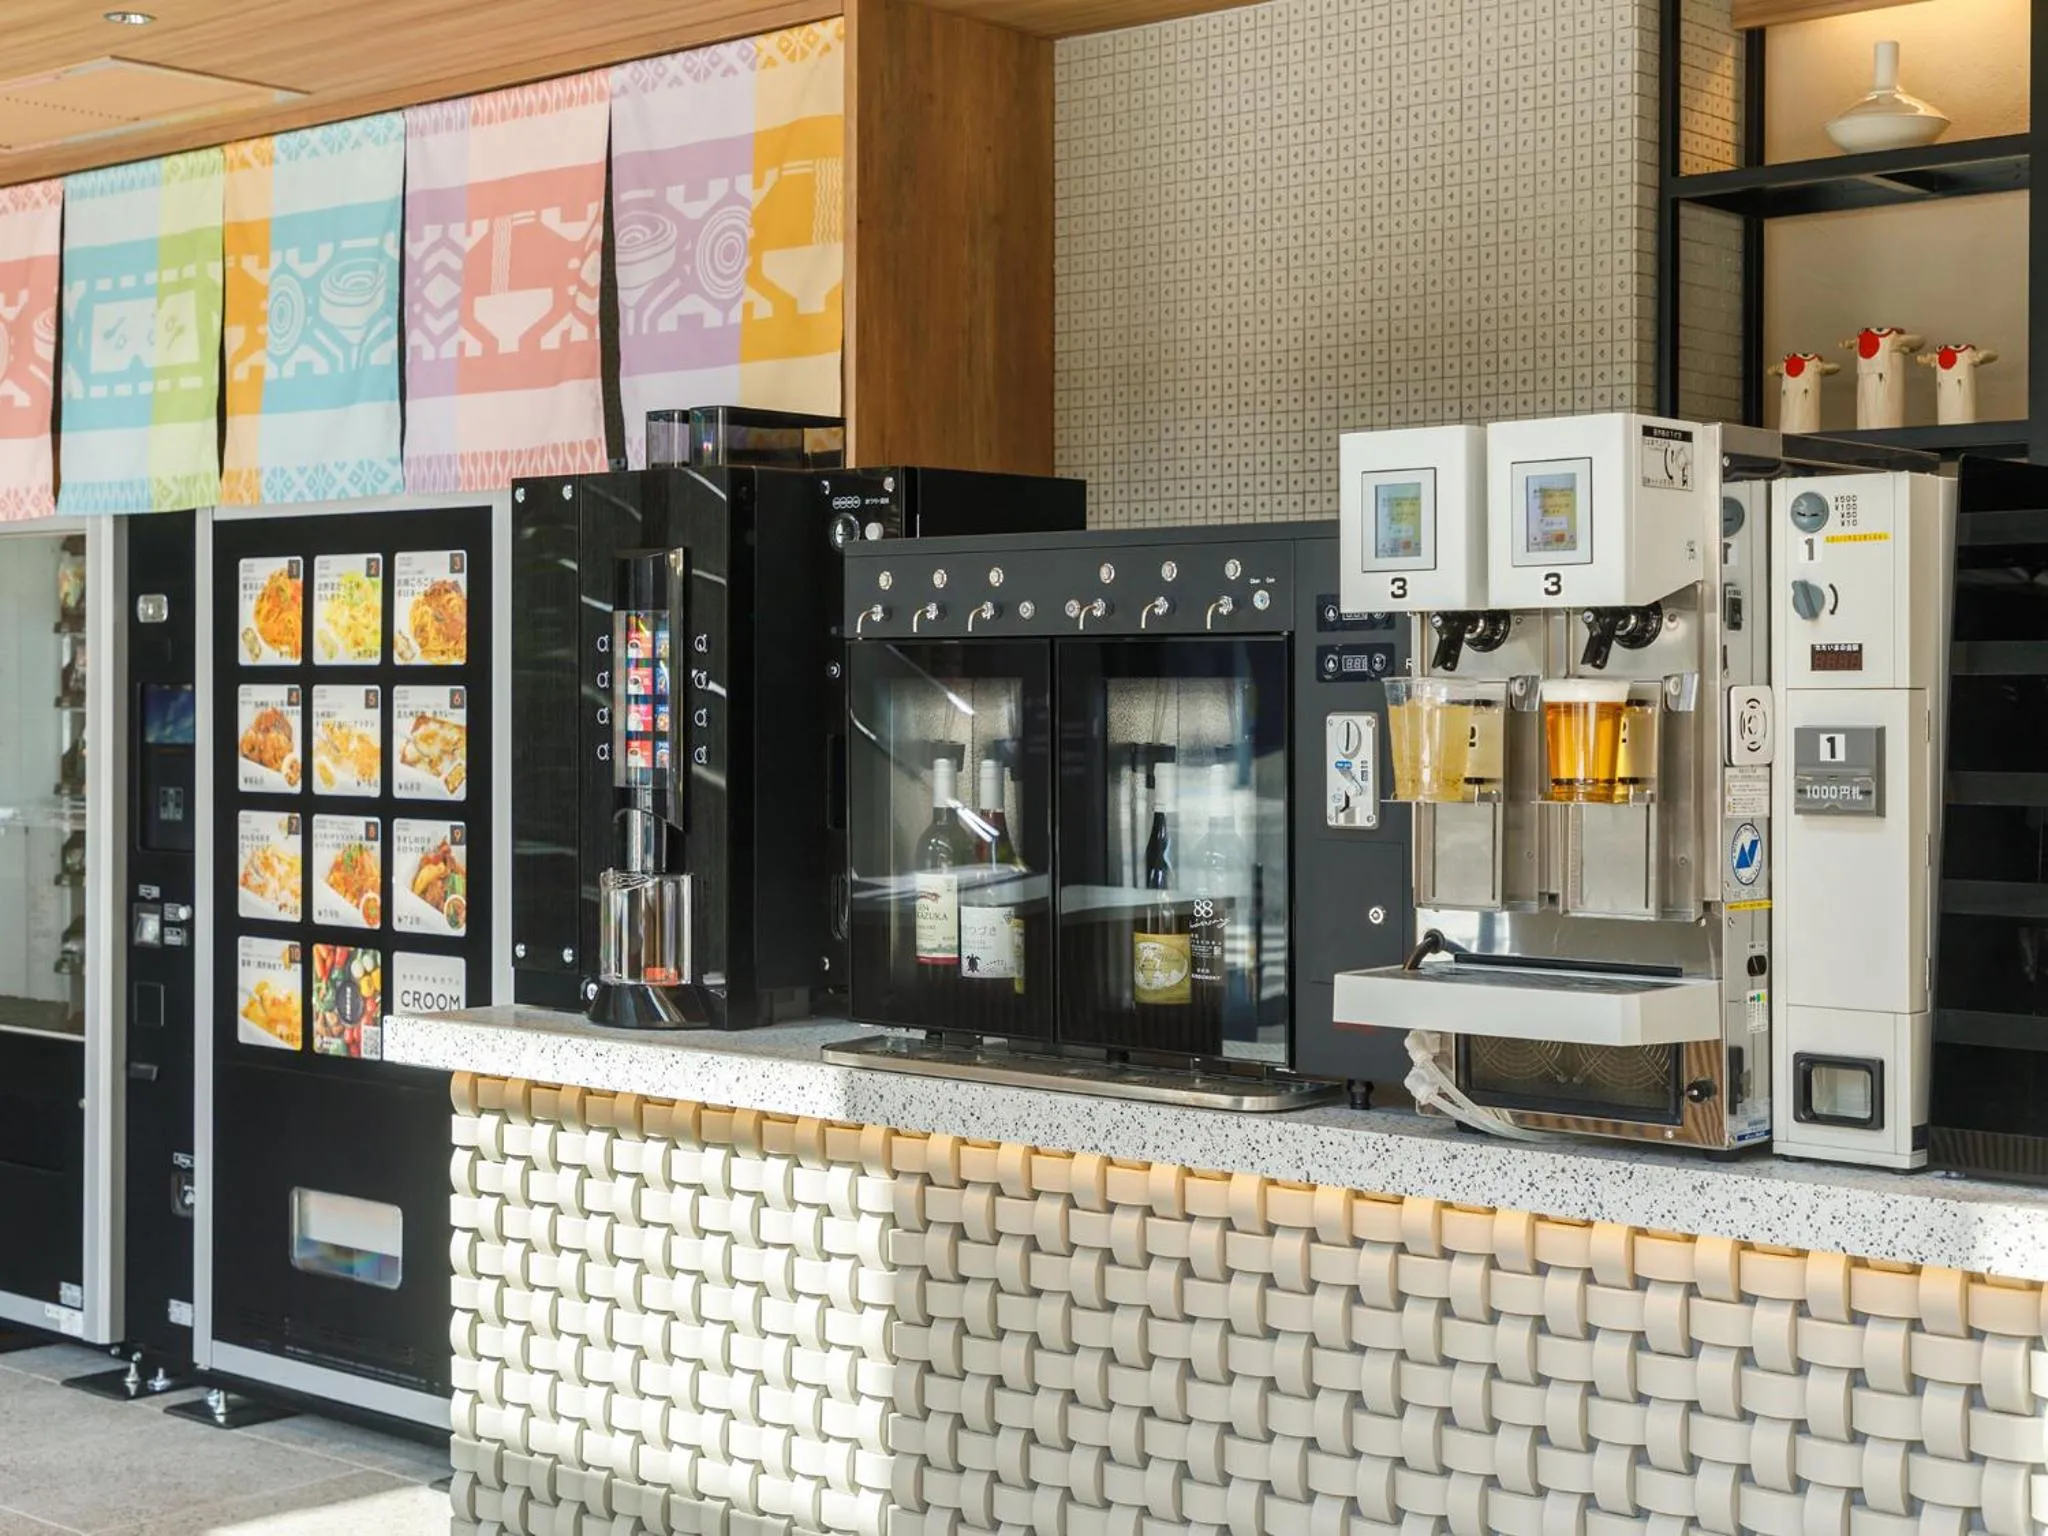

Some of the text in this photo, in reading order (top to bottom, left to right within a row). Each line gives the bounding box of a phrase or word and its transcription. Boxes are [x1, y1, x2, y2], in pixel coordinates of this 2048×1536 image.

[1835, 495, 1857, 503] ¥500
[1835, 503, 1857, 511] ¥100
[1841, 511, 1857, 519] ¥50
[1841, 519, 1857, 527] ¥10
[1805, 538, 1814, 561] 1
[1390, 577, 1408, 599] 3
[1544, 573, 1562, 596] 3
[1826, 736, 1836, 760] 1
[1806, 785, 1863, 800] 1000円札
[1193, 899, 1214, 918] 88
[401, 990, 461, 1010] CROOM
